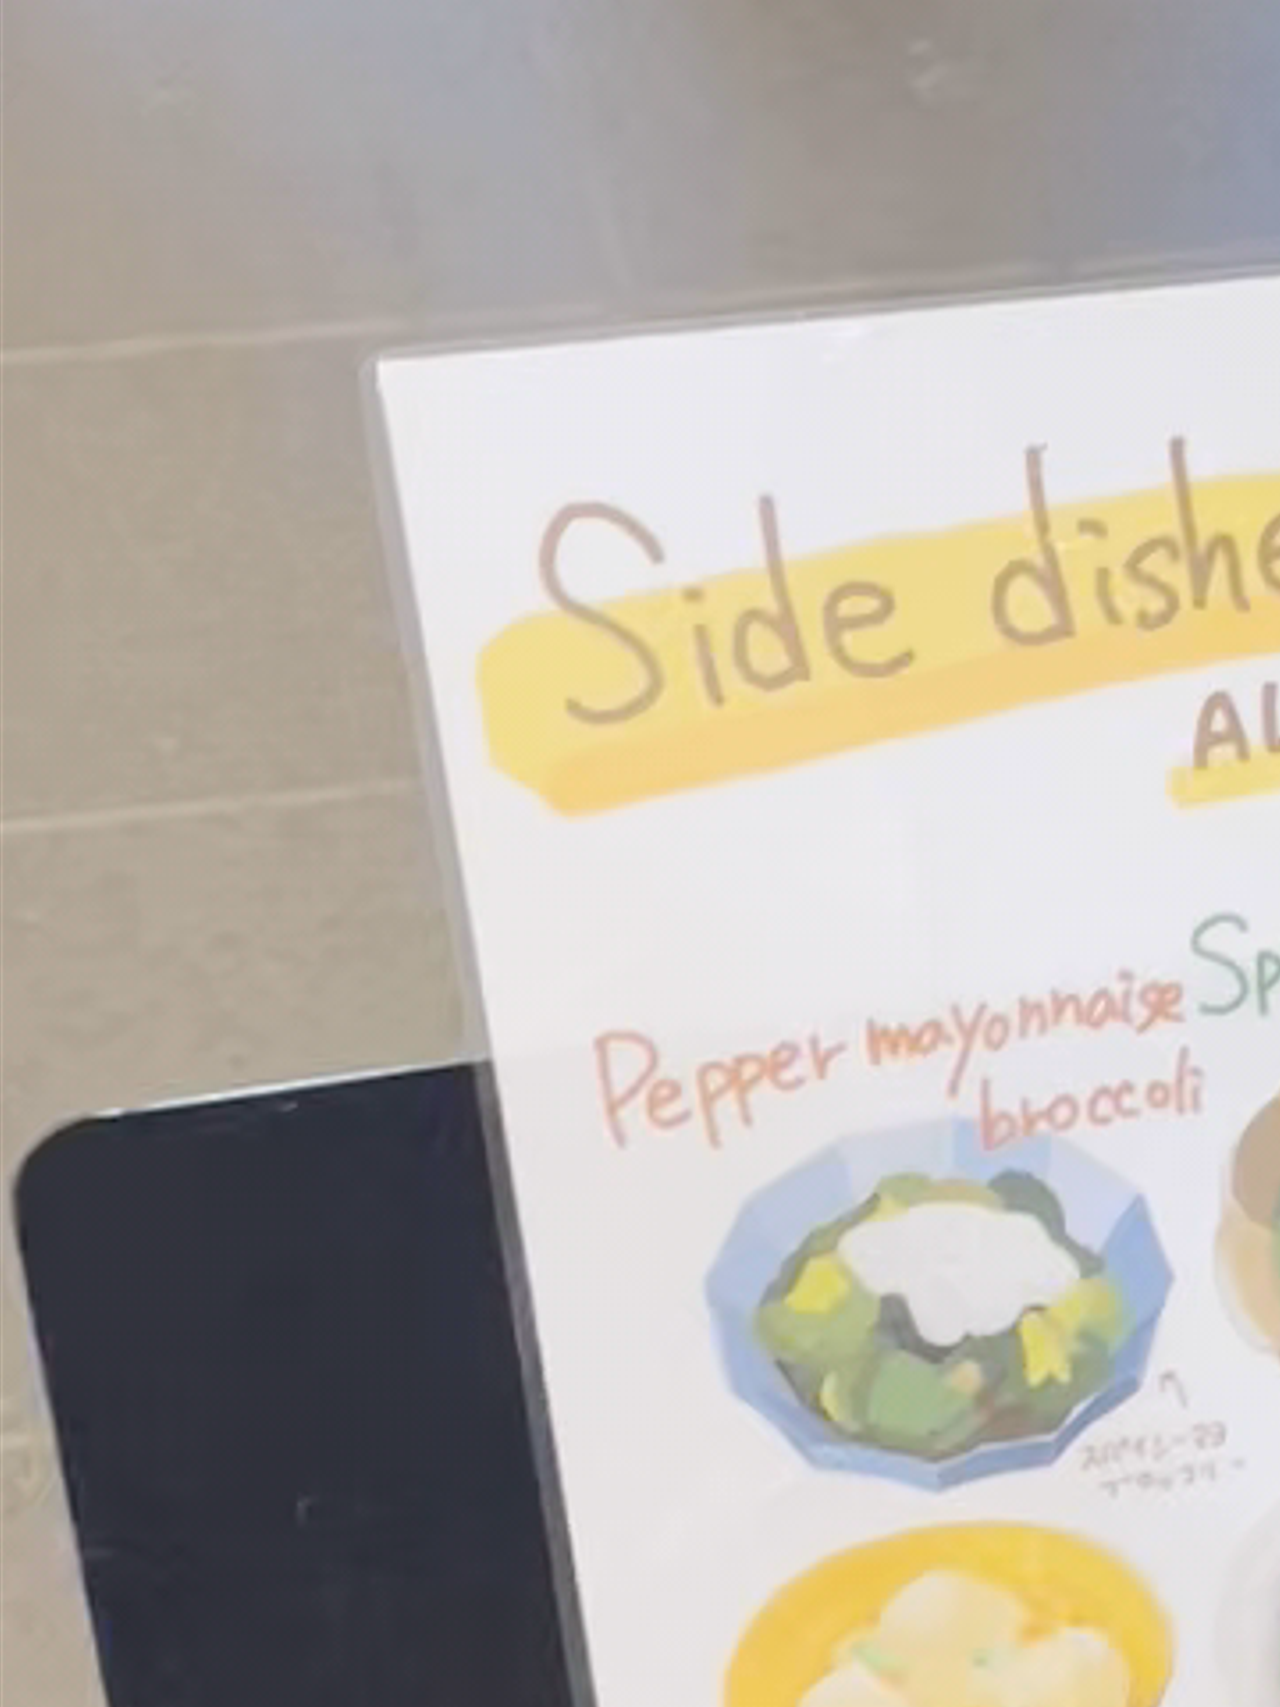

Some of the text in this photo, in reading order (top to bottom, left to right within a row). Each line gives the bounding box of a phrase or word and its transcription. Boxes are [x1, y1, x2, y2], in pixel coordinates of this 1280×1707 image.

[539, 495, 914, 725] Side
[593, 973, 1187, 1148] Pepper mayonnaise
[977, 1064, 1205, 1154] broccoli
